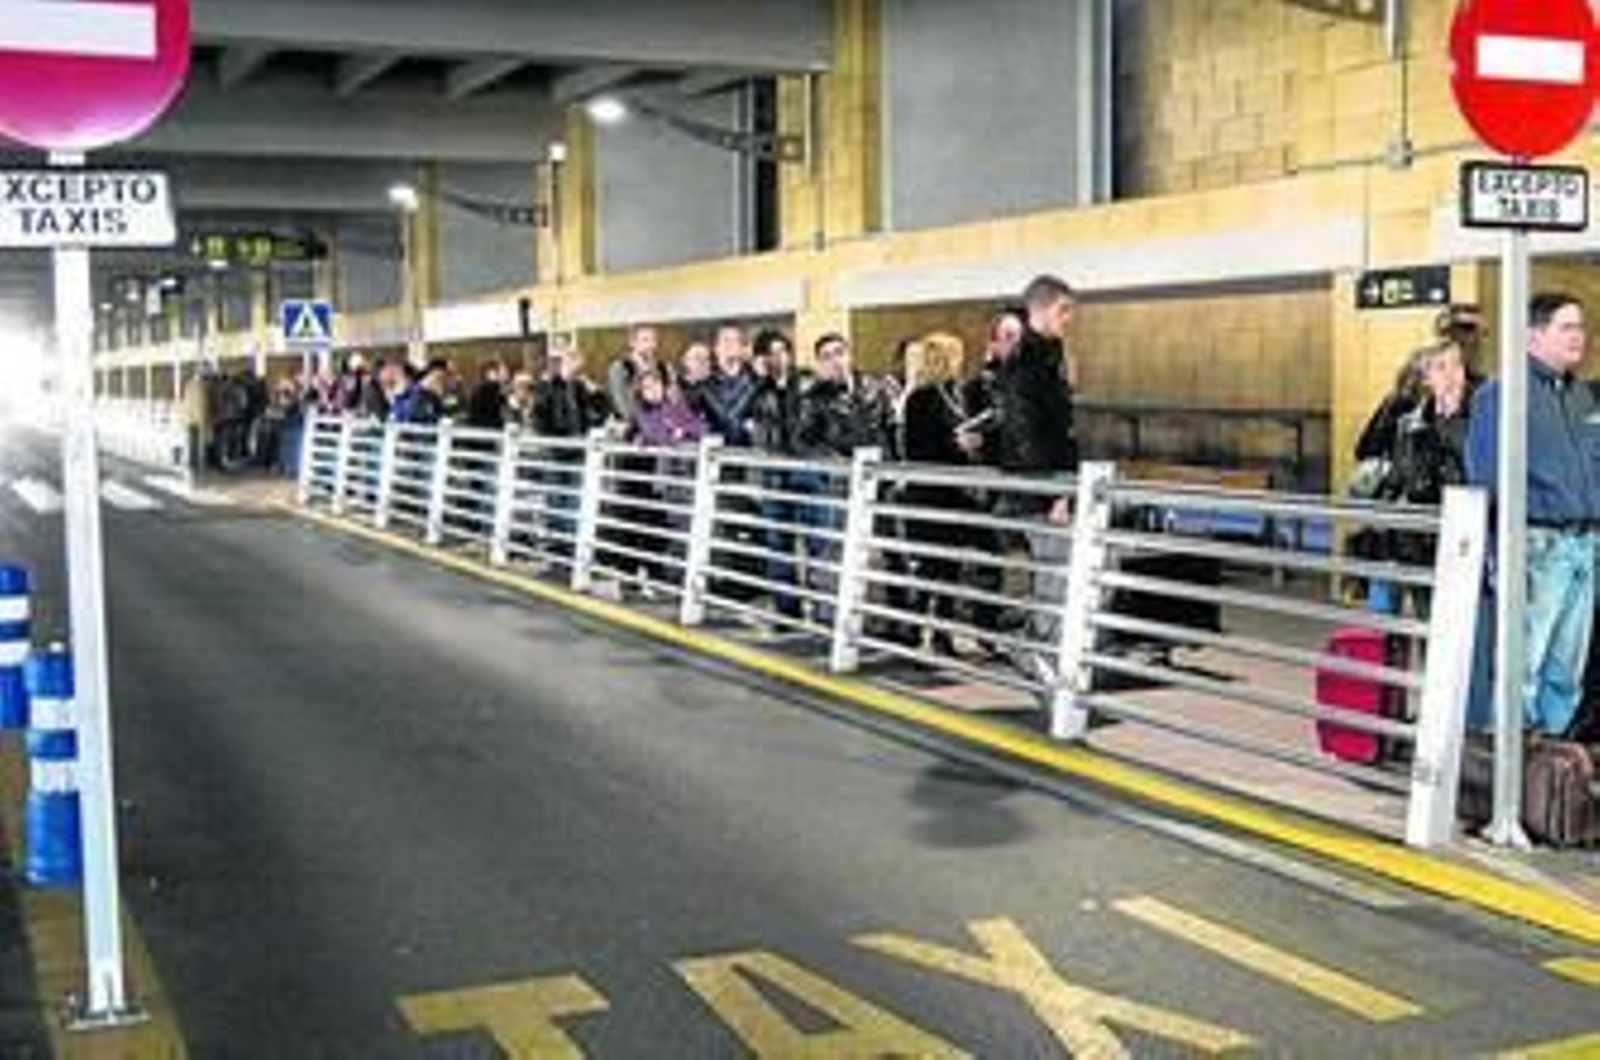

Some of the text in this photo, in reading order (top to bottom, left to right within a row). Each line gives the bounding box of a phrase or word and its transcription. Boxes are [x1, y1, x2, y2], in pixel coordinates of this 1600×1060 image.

[1478, 169, 1580, 199] EXCEPTO
[16, 206, 129, 234] TAXIS
[1496, 196, 1562, 221] TAXIS
[398, 895, 1424, 1060] TAXI
